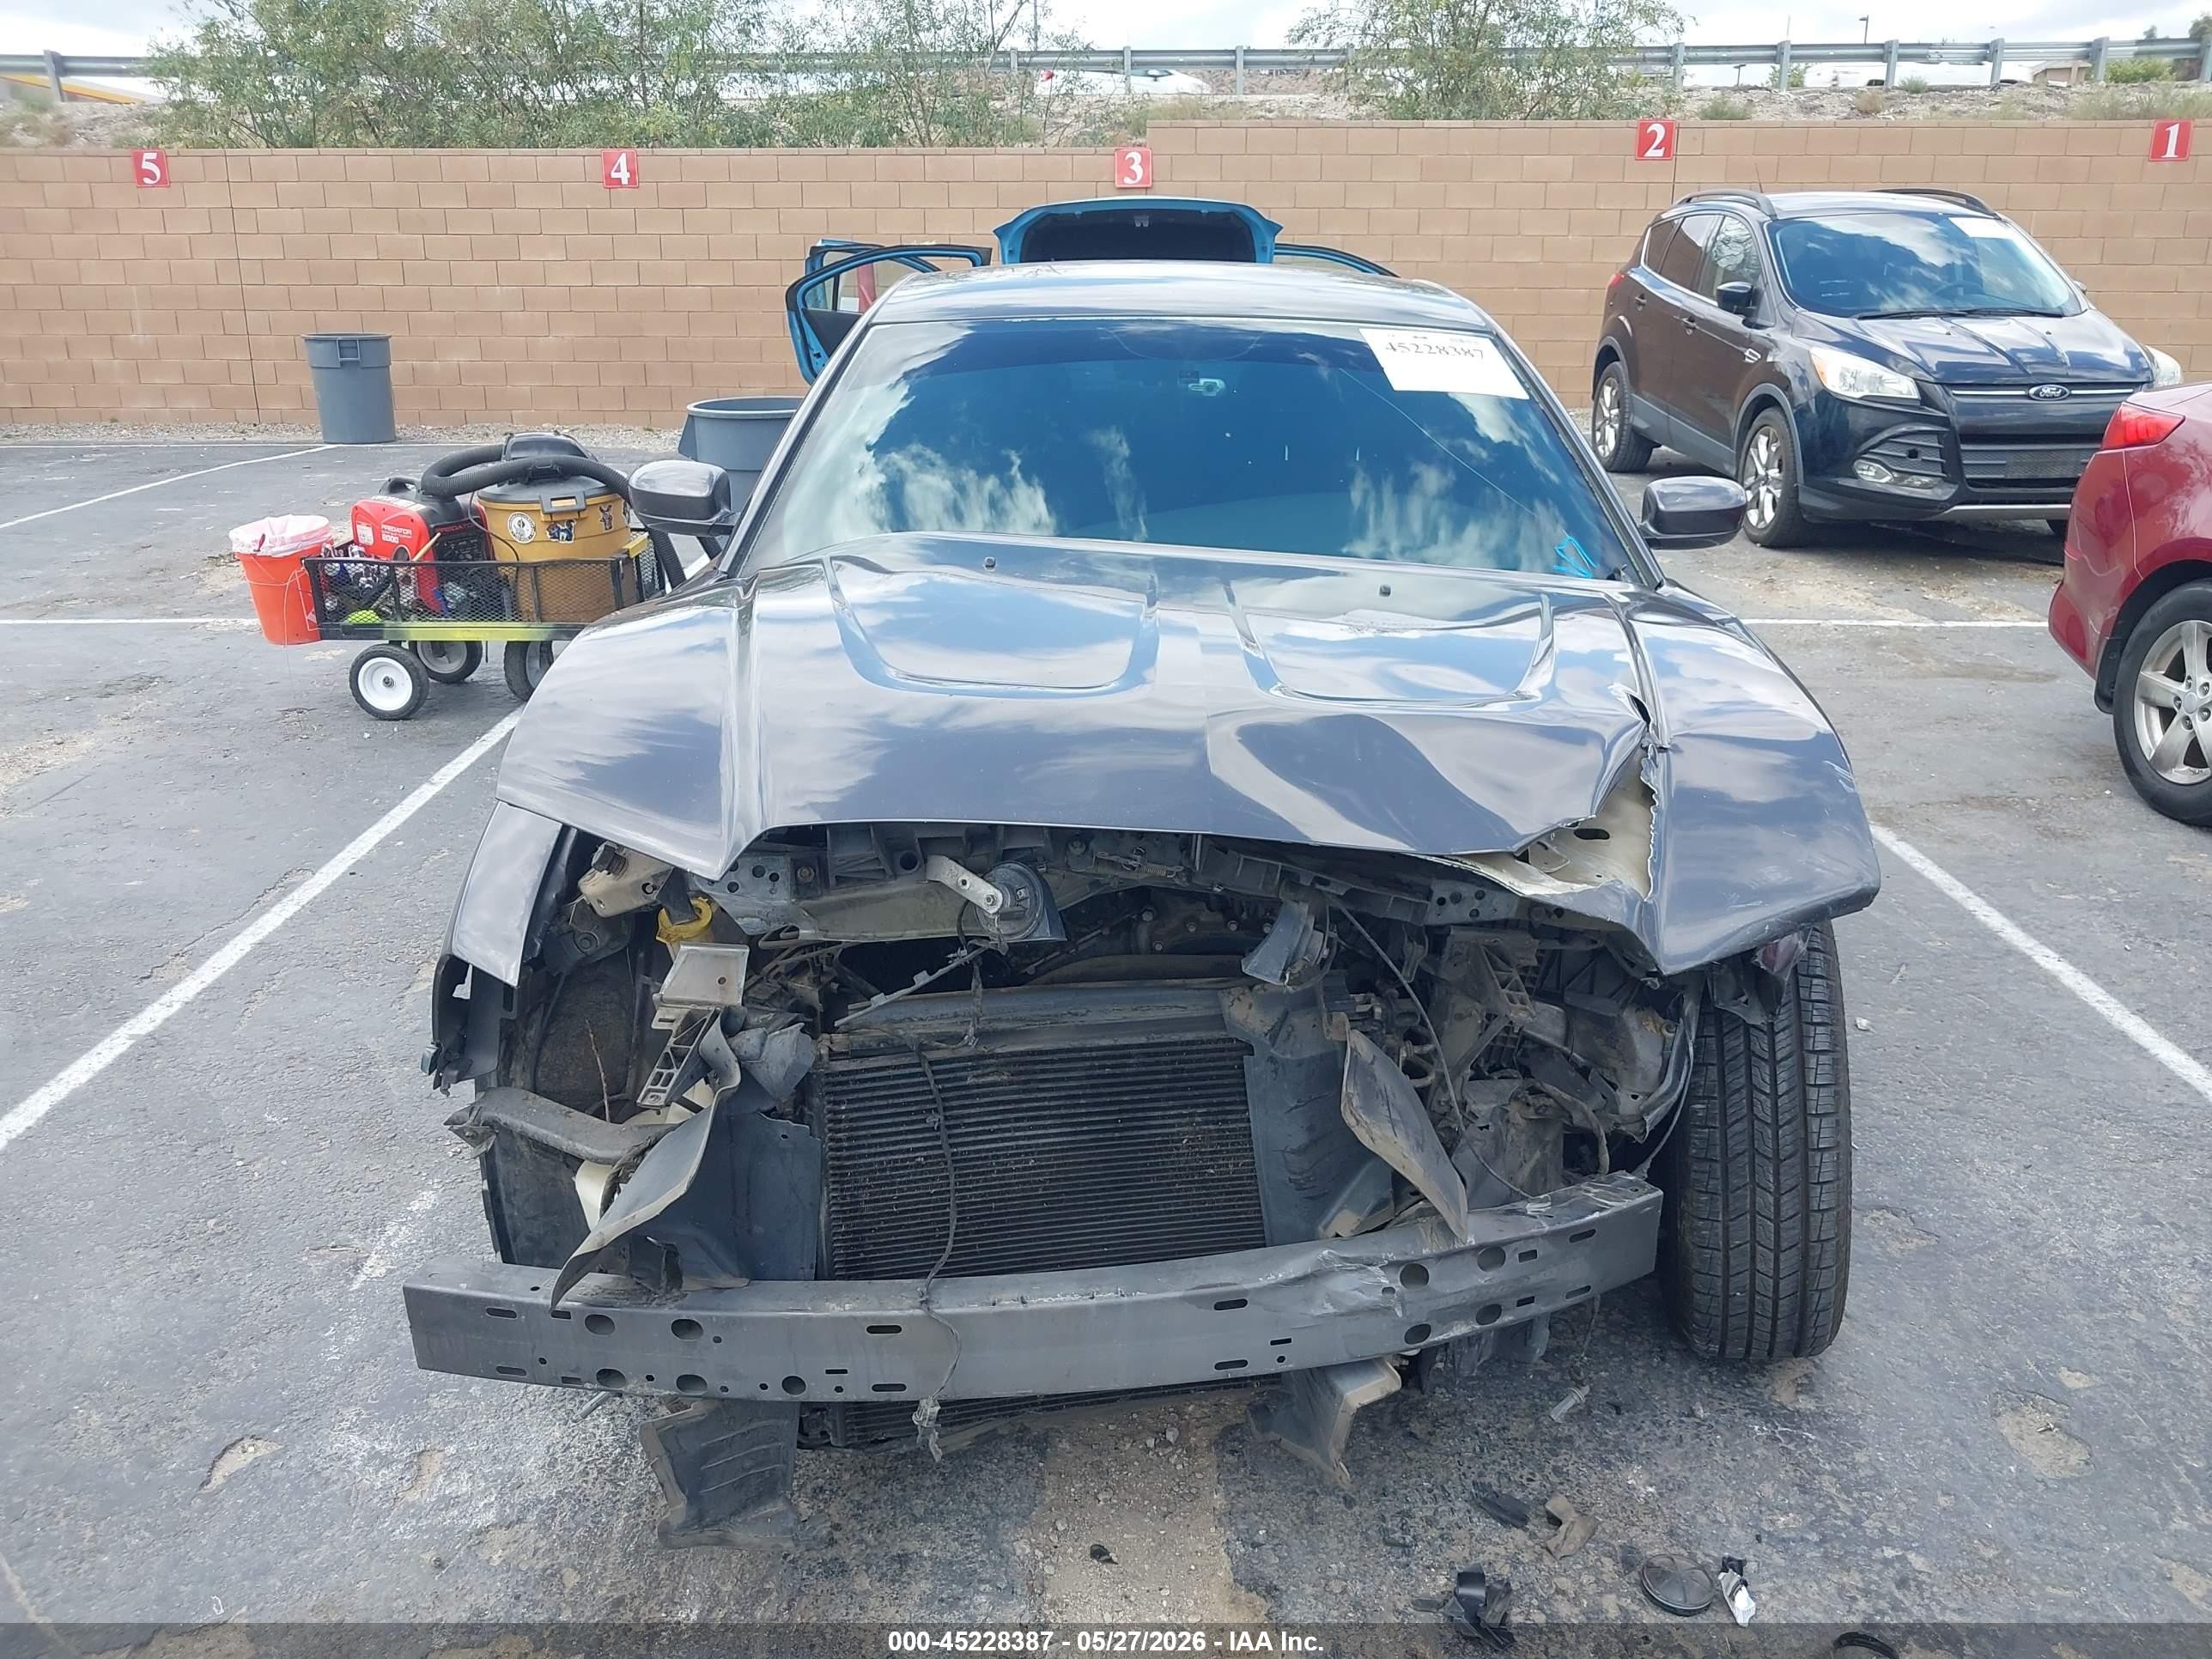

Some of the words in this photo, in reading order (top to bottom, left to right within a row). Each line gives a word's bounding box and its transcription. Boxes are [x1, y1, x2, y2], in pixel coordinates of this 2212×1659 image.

[1644, 125, 1665, 156] 2
[2162, 125, 2179, 157] 1
[142, 153, 161, 185] 5
[611, 152, 631, 185] 4
[1123, 151, 1144, 184] 3
[1385, 342, 1484, 359] 45228387
[2039, 386, 2062, 398] Ford
[381, 524, 412, 535] PREDATOR
